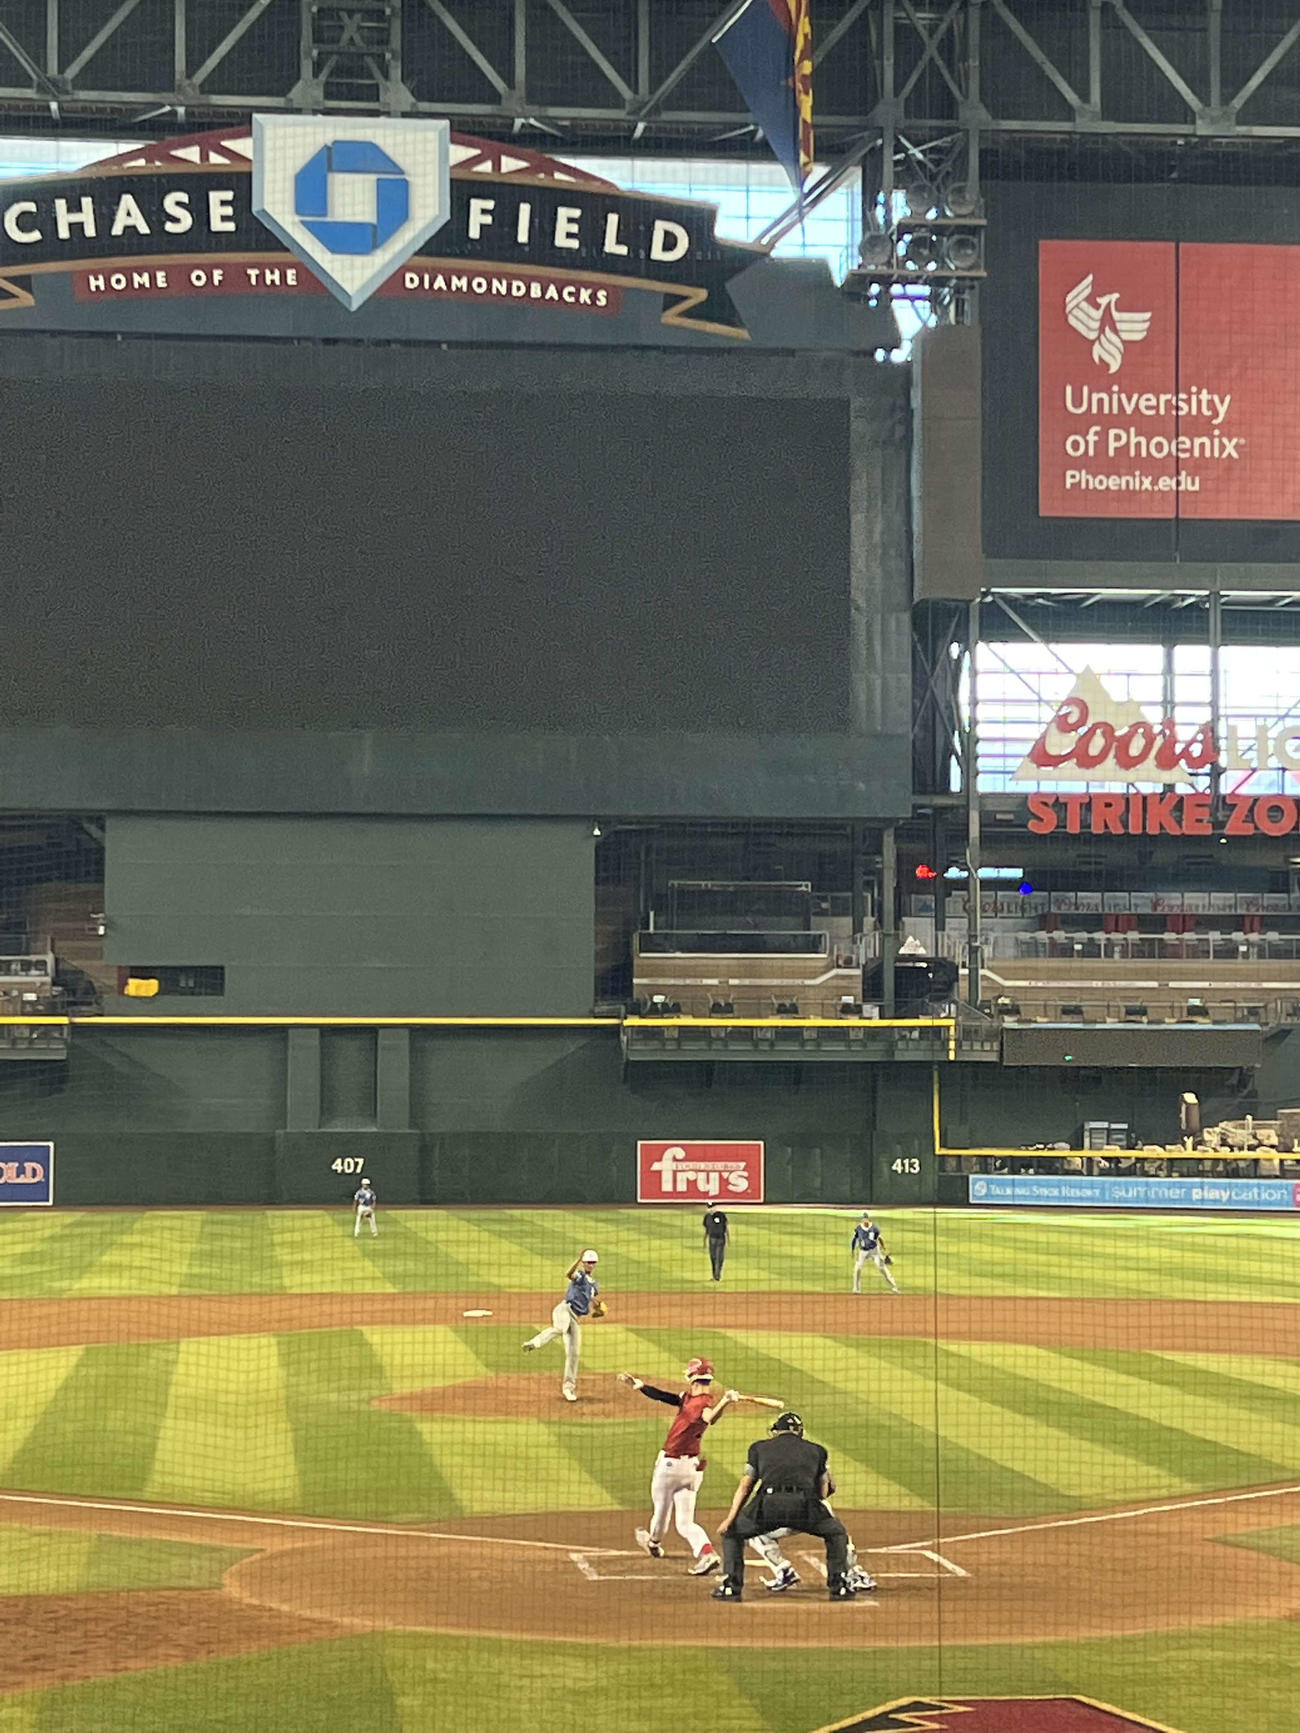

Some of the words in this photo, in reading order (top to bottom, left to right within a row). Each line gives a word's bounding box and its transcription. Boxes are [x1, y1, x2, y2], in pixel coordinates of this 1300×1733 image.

[4, 190, 236, 243] CHASE
[468, 197, 690, 262] FIELD
[88, 269, 168, 292] HOME
[190, 268, 224, 287] OF
[246, 267, 299, 287] THE
[404, 271, 609, 307] DIAMONDBACKS
[1065, 384, 1231, 425] University
[1065, 426, 1101, 457] of
[1108, 427, 1240, 459] Phoenix
[1065, 470, 1200, 491] Phoenix.edu
[1028, 696, 1219, 771] Coors
[1027, 793, 1213, 835] STRIKE
[1224, 793, 1300, 837] ZO
[331, 1157, 364, 1174] 407
[650, 1146, 749, 1196] fry's
[891, 1158, 920, 1174] 413
[1111, 1185, 1187, 1199] summer
[1192, 1185, 1288, 1202] playcation
